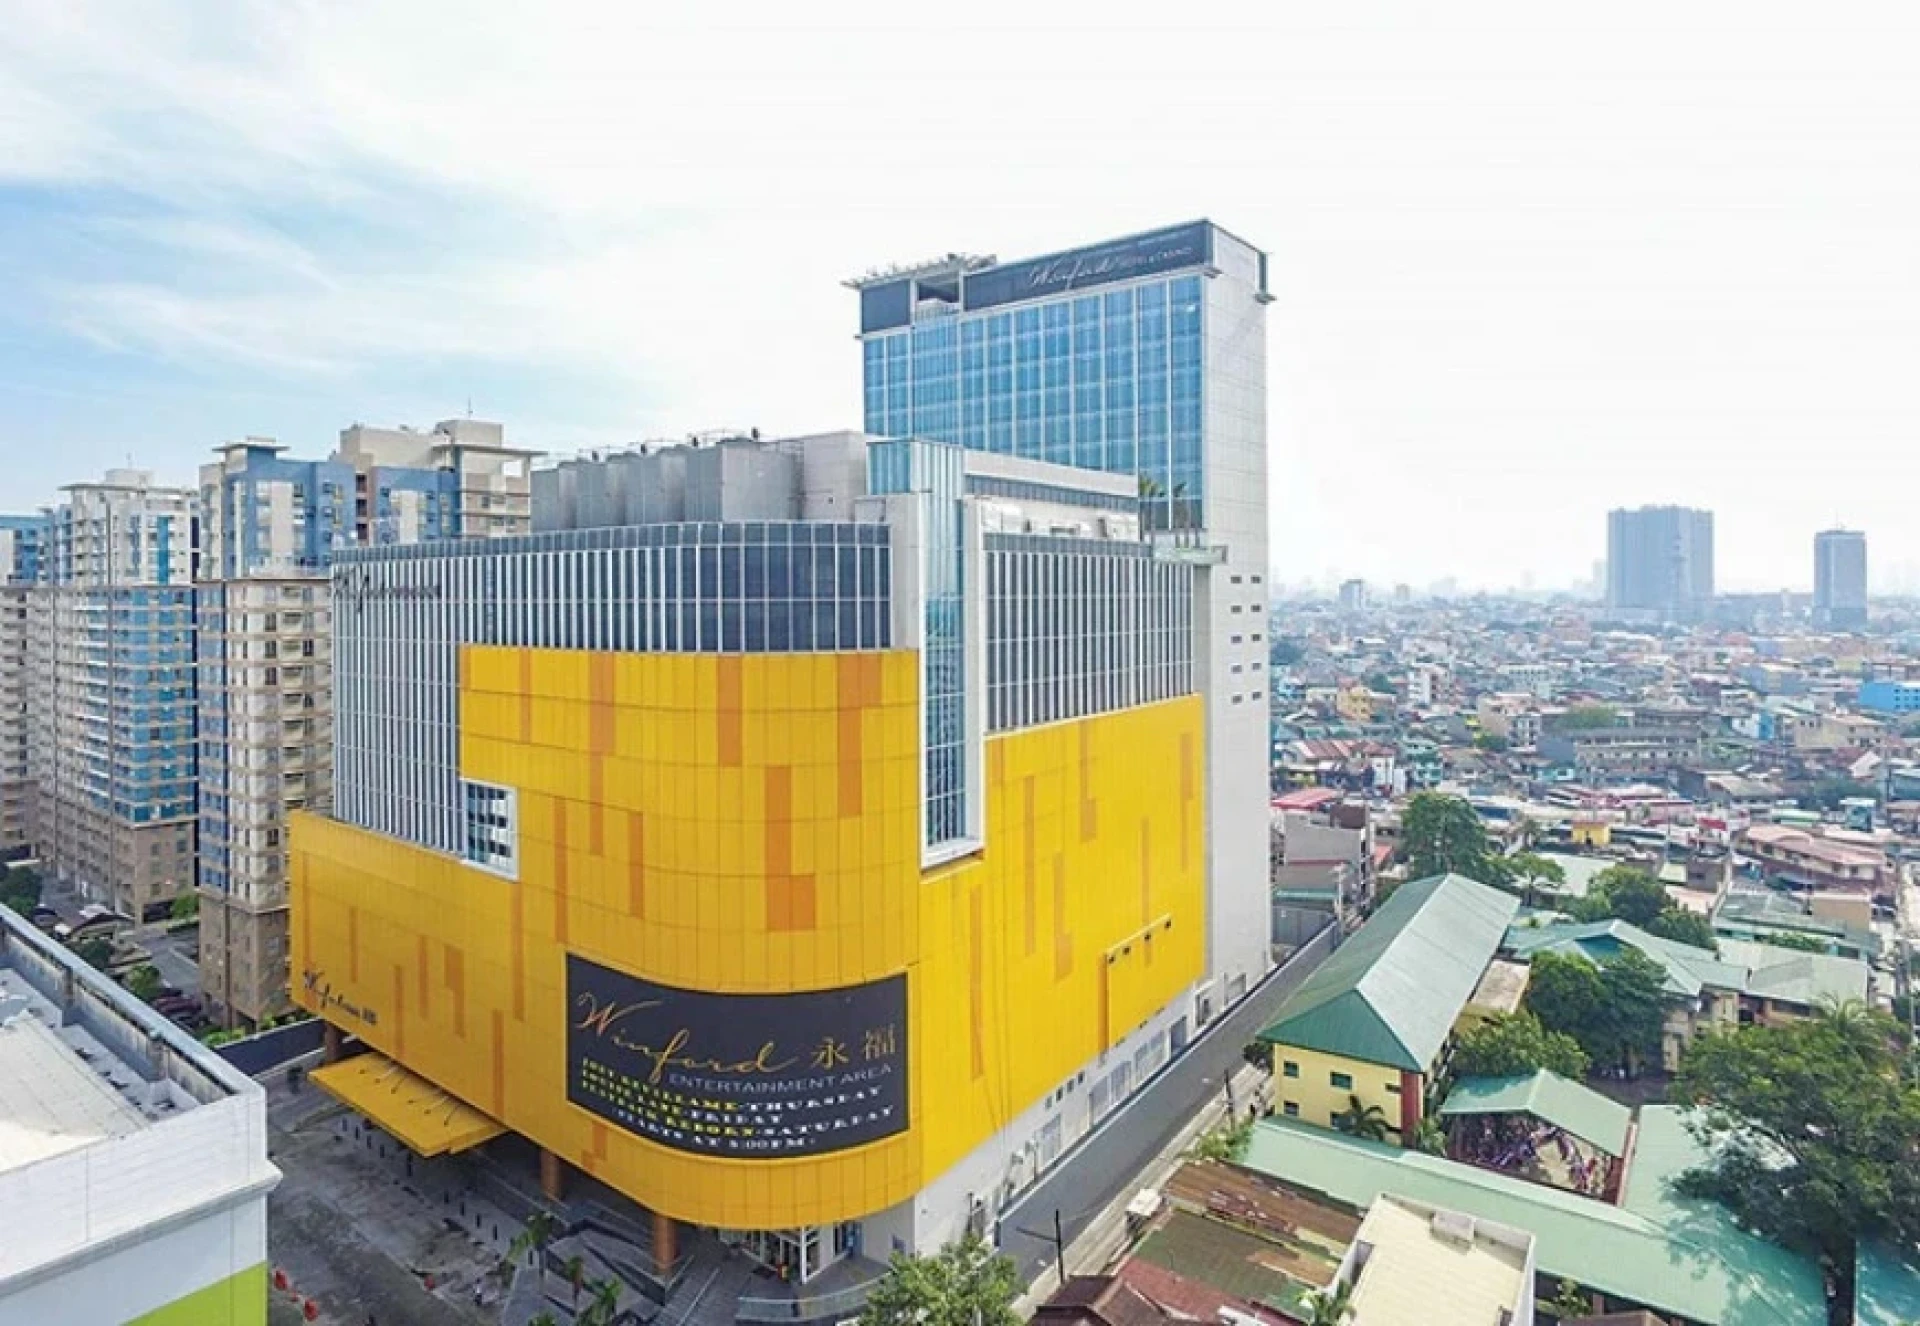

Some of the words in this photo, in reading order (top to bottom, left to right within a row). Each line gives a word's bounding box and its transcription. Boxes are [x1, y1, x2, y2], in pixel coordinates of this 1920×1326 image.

[574, 990, 799, 1083] Winford
[668, 1072, 836, 1093] ENTERTAINMENT
[840, 1063, 893, 1086] AREA
